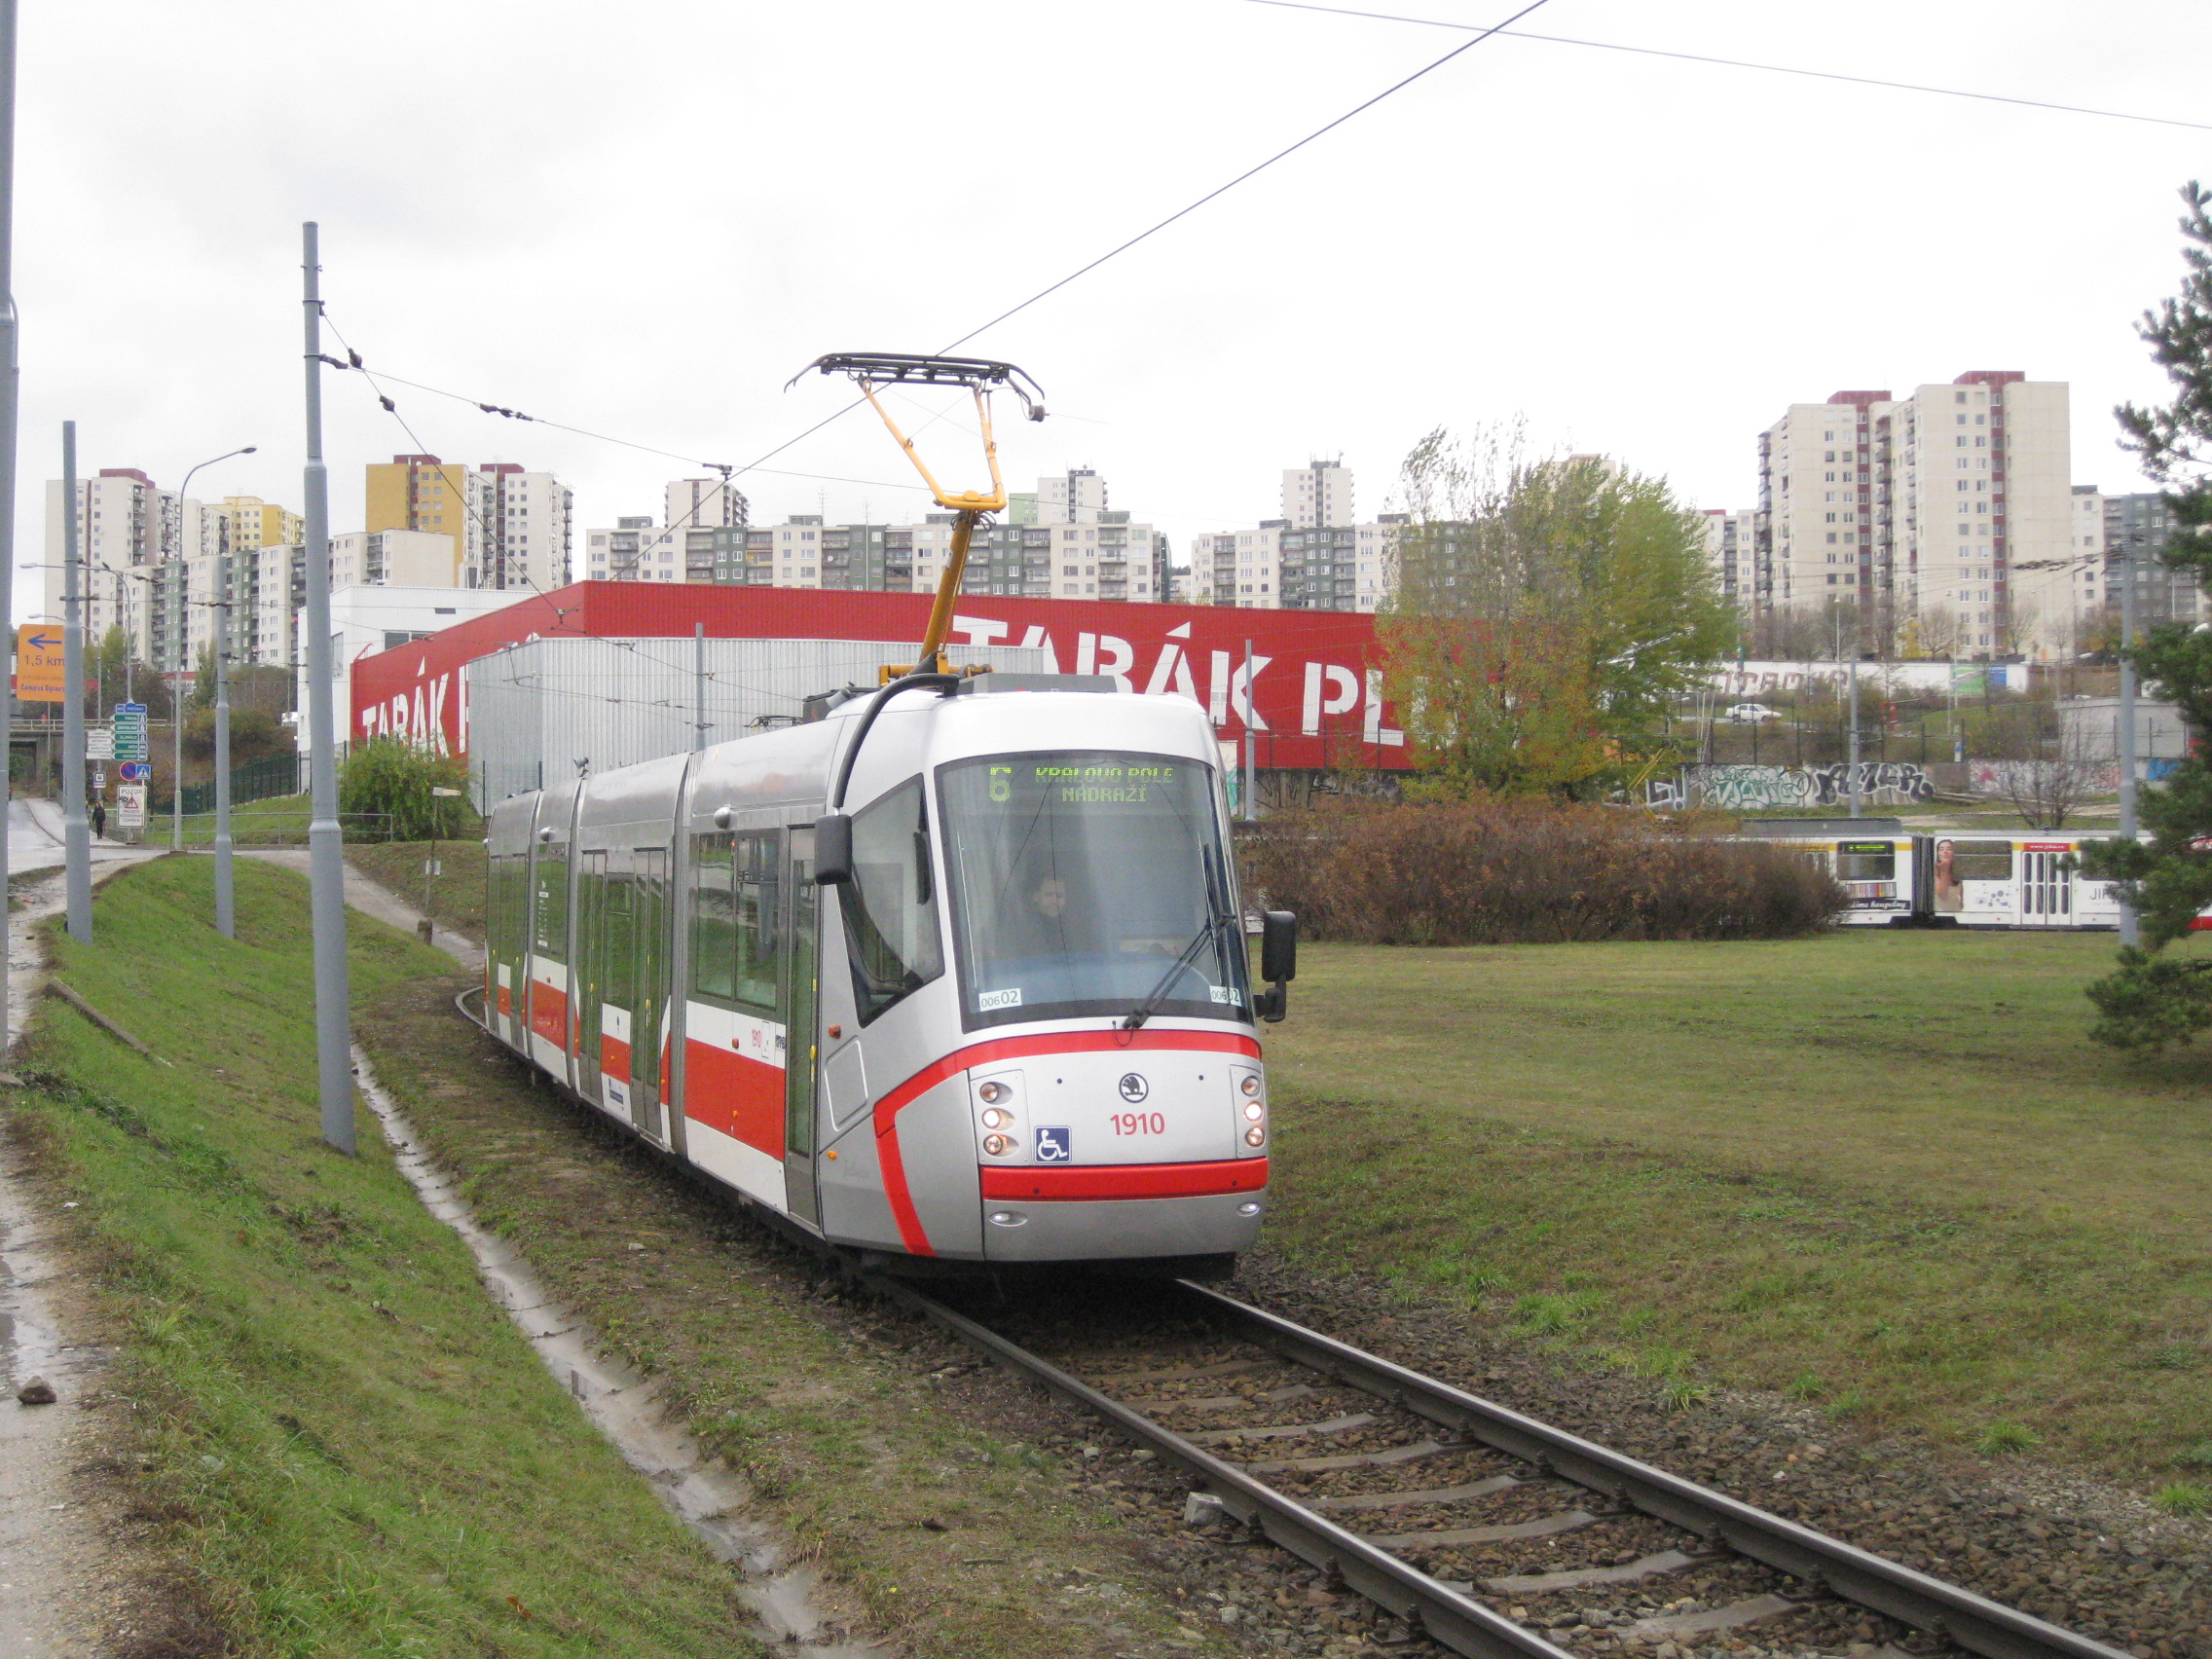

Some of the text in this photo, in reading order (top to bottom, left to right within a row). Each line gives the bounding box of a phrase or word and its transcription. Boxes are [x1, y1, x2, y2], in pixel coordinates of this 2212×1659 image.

[25, 654, 65, 667] 1,5 km
[988, 766, 1013, 802] 6
[1127, 766, 1176, 783] POLE
[1062, 783, 1147, 802] NÁDRAŽÍ
[980, 990, 1018, 1008] 00602
[1110, 1112, 1165, 1136] 1910
